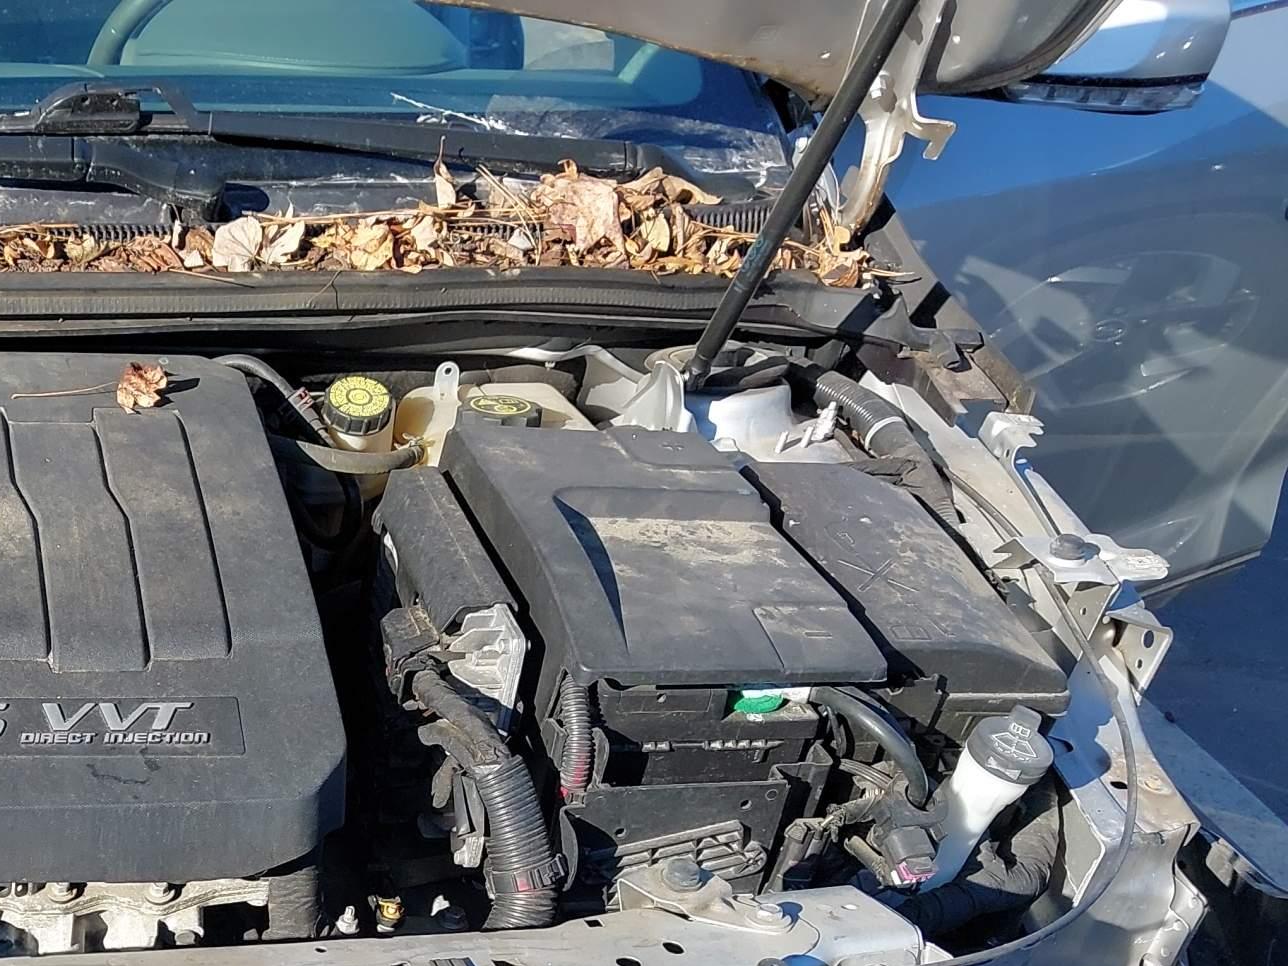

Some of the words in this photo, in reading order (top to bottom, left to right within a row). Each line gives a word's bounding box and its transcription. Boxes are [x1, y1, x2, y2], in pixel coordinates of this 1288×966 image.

[41, 701, 195, 732] VVT
[19, 732, 98, 745] DIRECT
[104, 732, 212, 745] INJECTION
